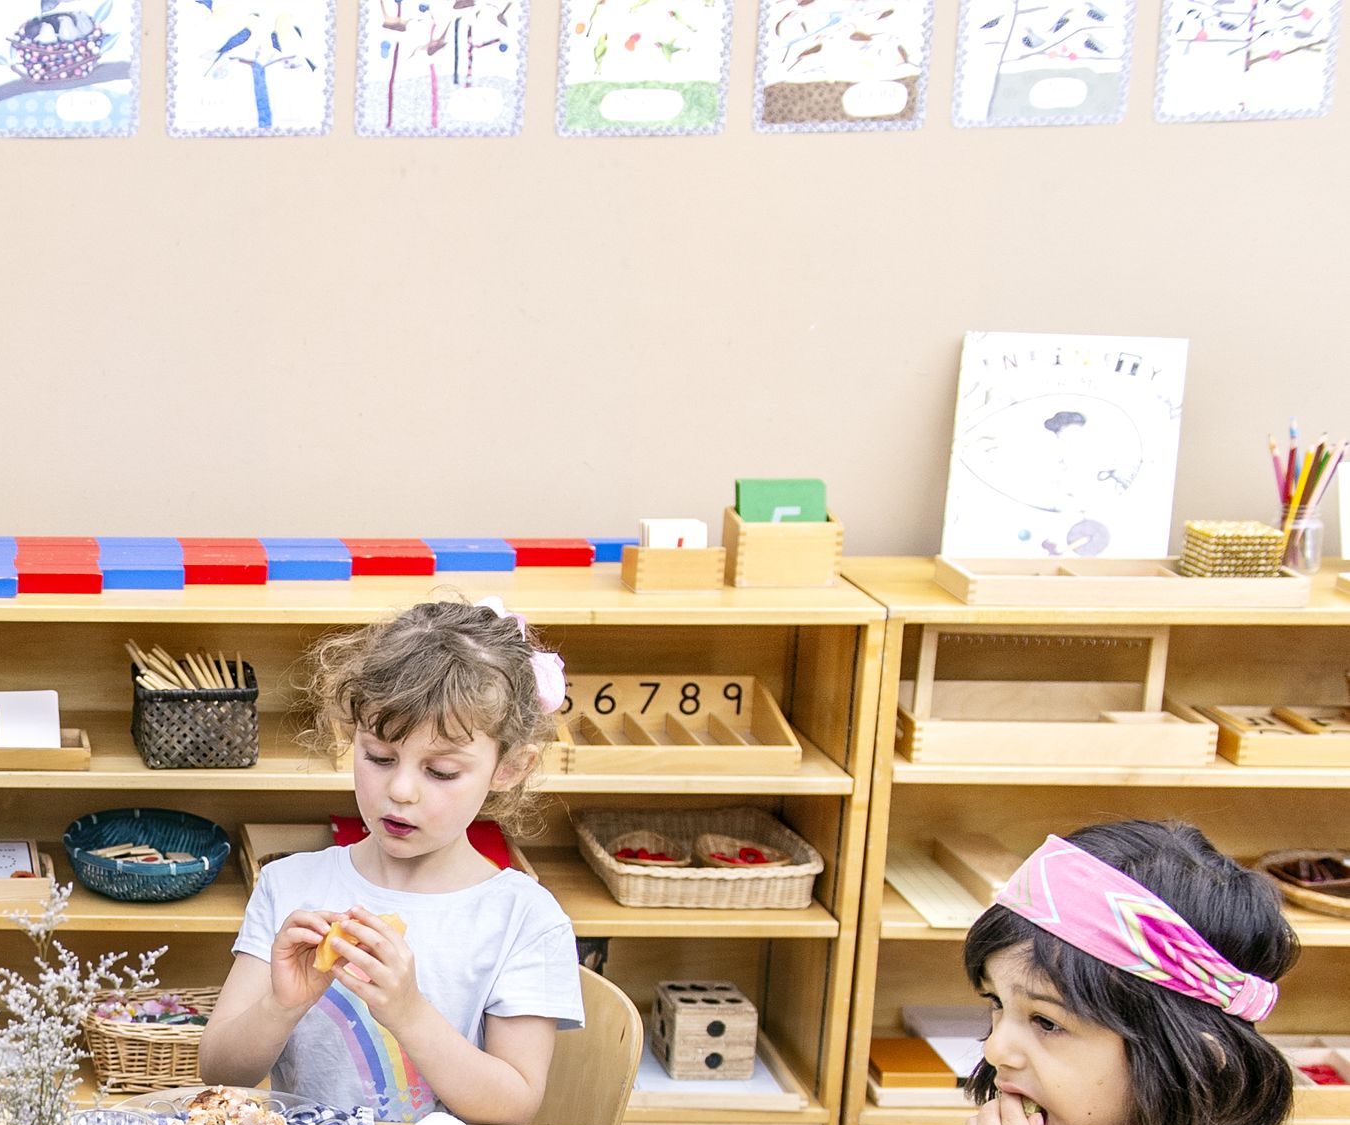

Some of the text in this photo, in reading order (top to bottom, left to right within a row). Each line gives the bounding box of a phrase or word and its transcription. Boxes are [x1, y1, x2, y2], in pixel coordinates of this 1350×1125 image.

[594, 683, 617, 715] 6
[639, 683, 661, 715] 7
[679, 683, 701, 715] 8
[723, 683, 743, 716] 9
